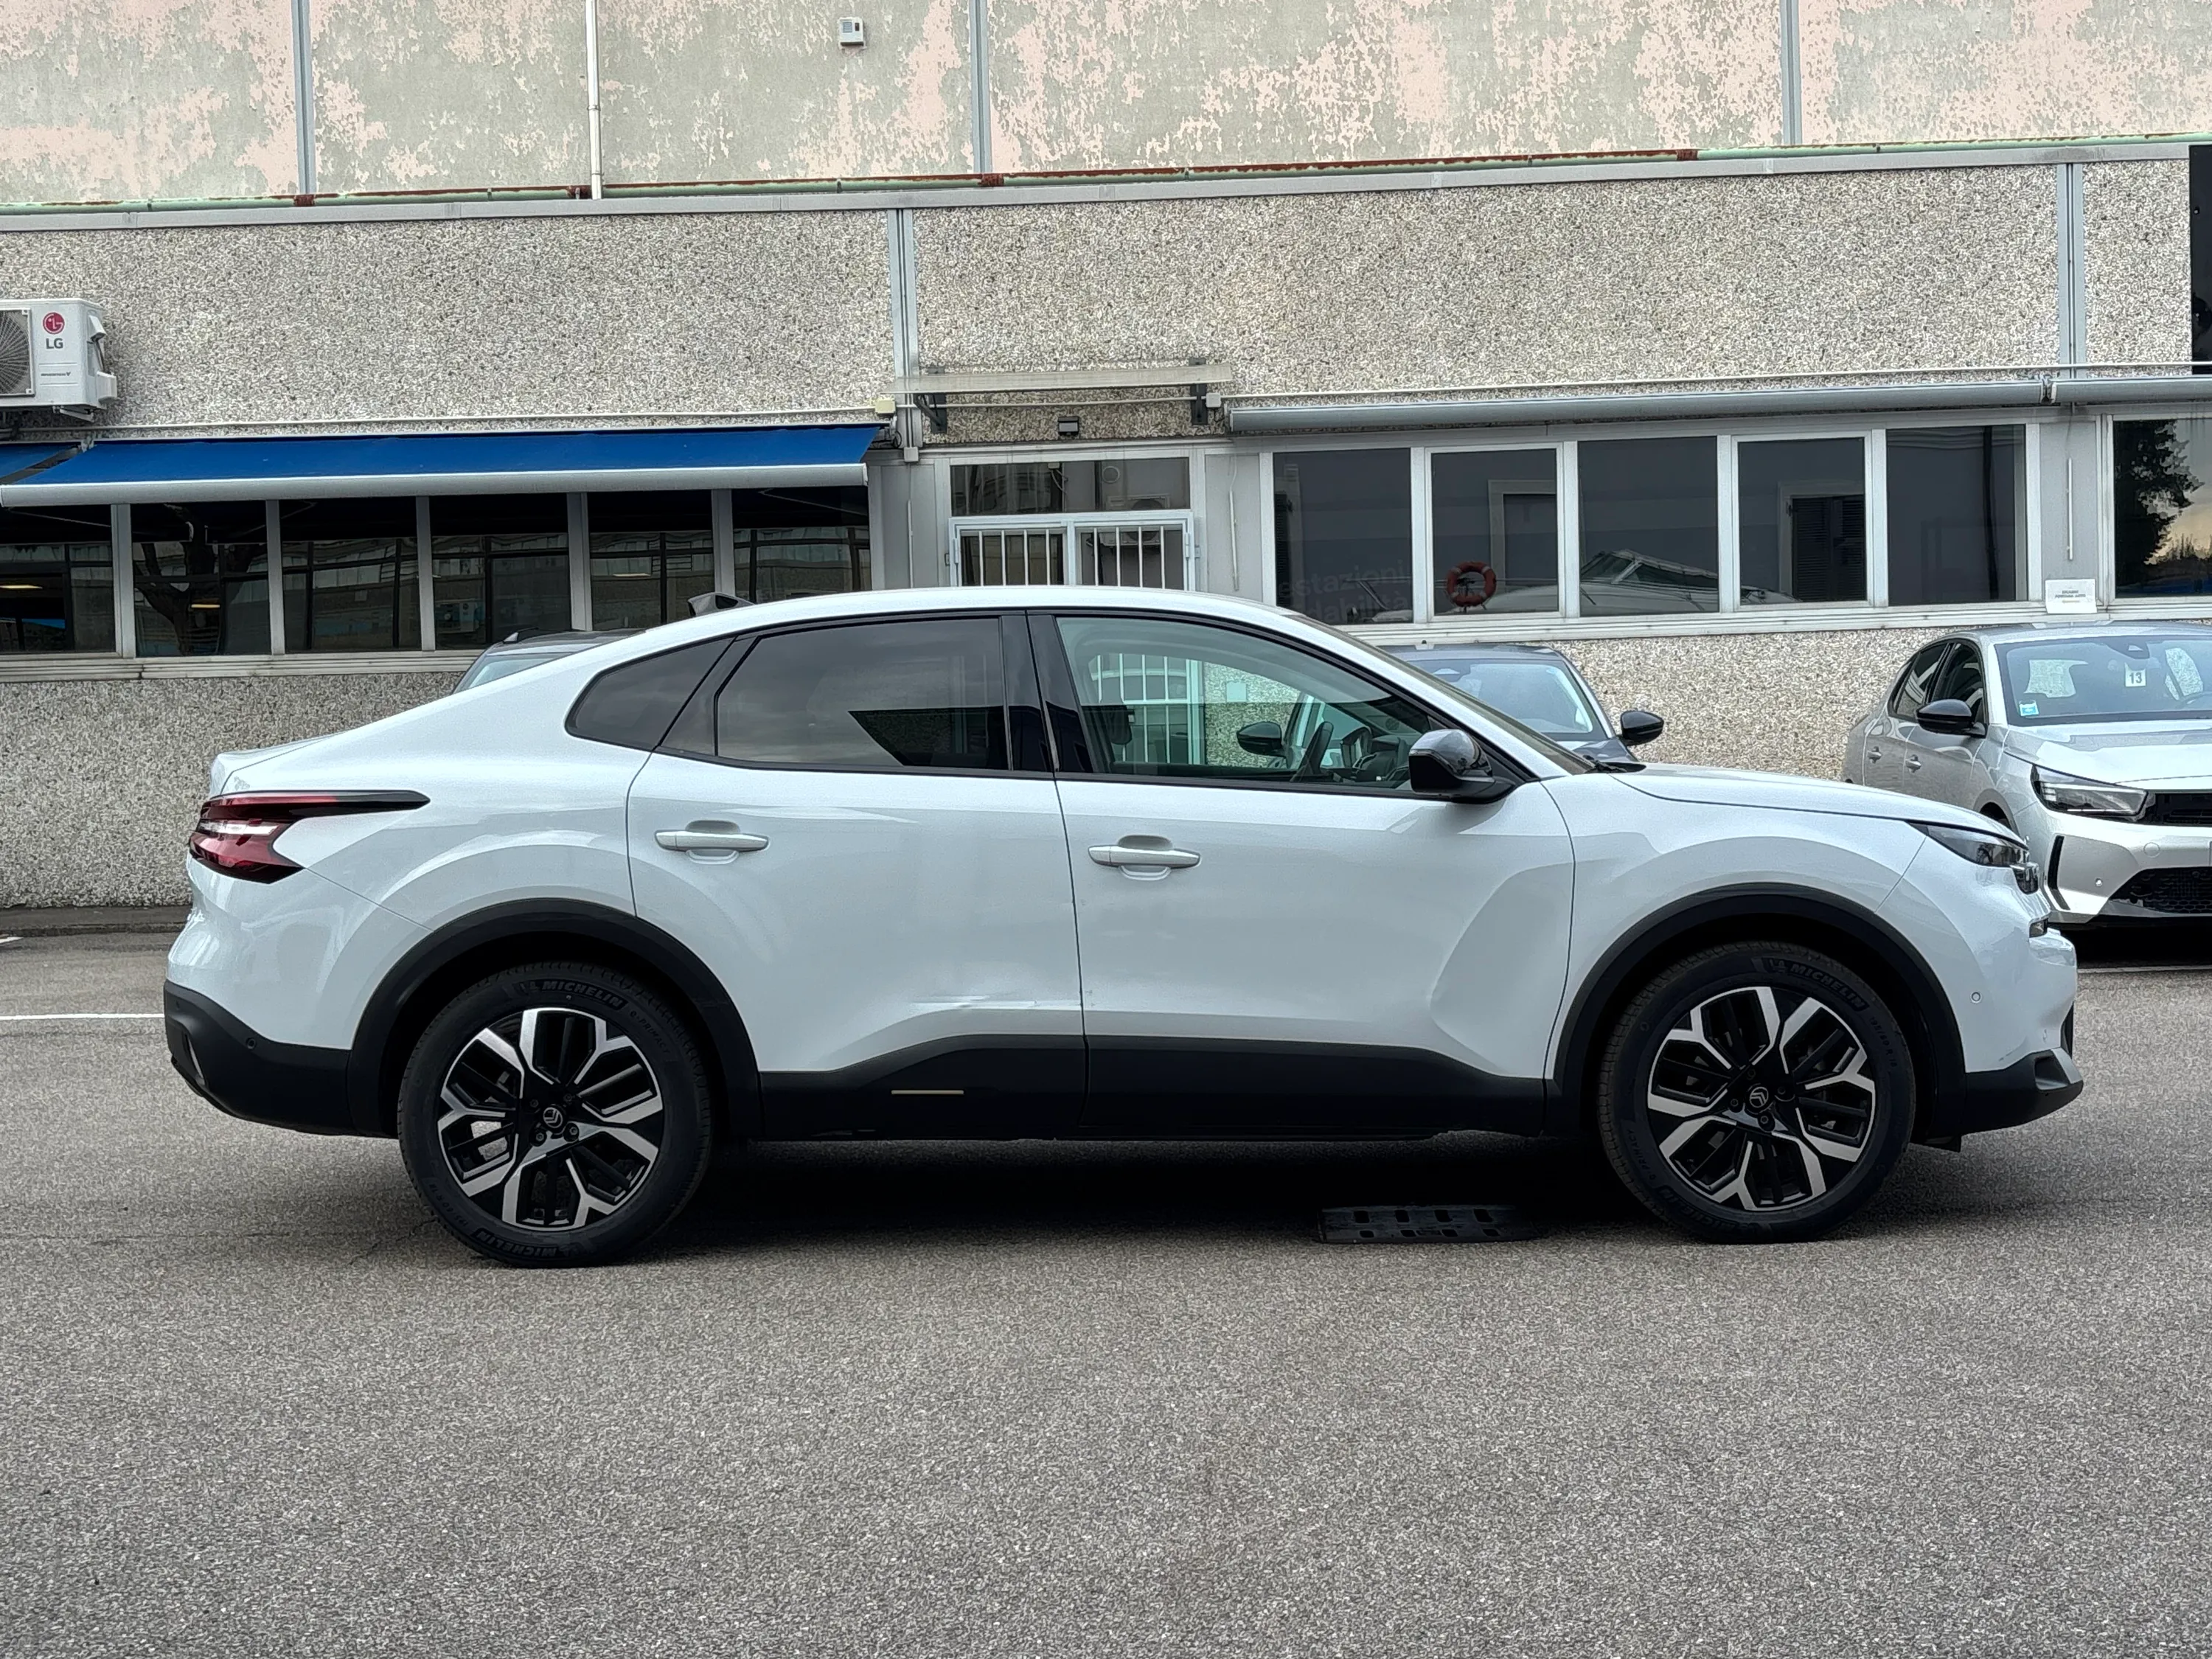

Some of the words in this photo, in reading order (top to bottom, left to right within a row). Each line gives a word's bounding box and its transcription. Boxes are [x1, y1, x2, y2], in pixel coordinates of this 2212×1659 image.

[46, 338, 64, 349] LG
[2129, 672, 2143, 684] 13
[542, 980, 624, 1008] MICHELIN
[1790, 964, 1867, 1009] MICHELIN
[476, 1230, 557, 1257] MICHELIN
